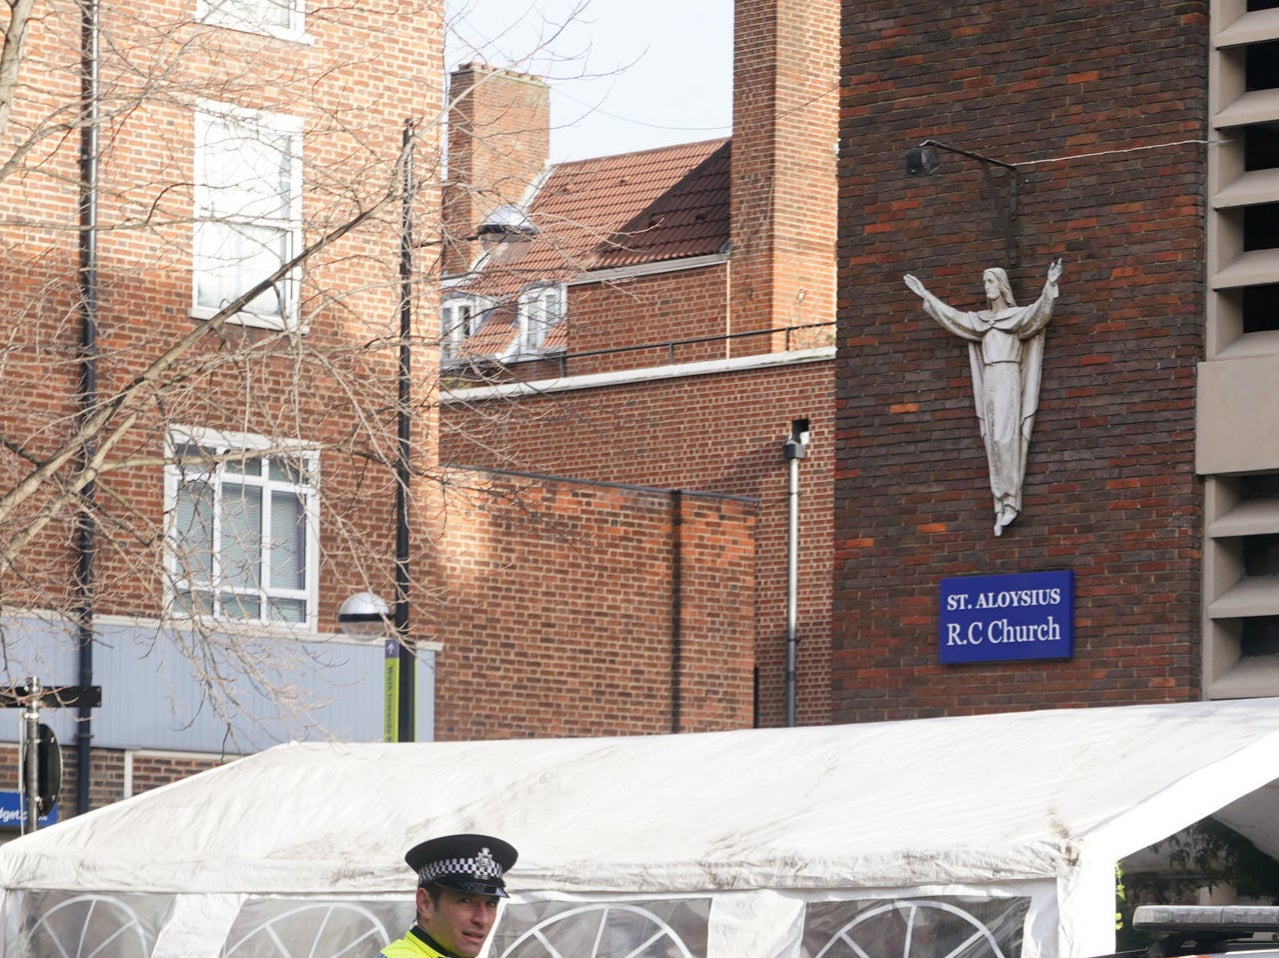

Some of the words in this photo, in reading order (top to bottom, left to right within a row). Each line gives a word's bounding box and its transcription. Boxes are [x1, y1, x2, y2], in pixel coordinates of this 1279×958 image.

[946, 594, 972, 611] ST.
[976, 588, 1061, 609] ALOYSIUS
[946, 621, 984, 646] R.C
[987, 616, 1061, 644] Church
